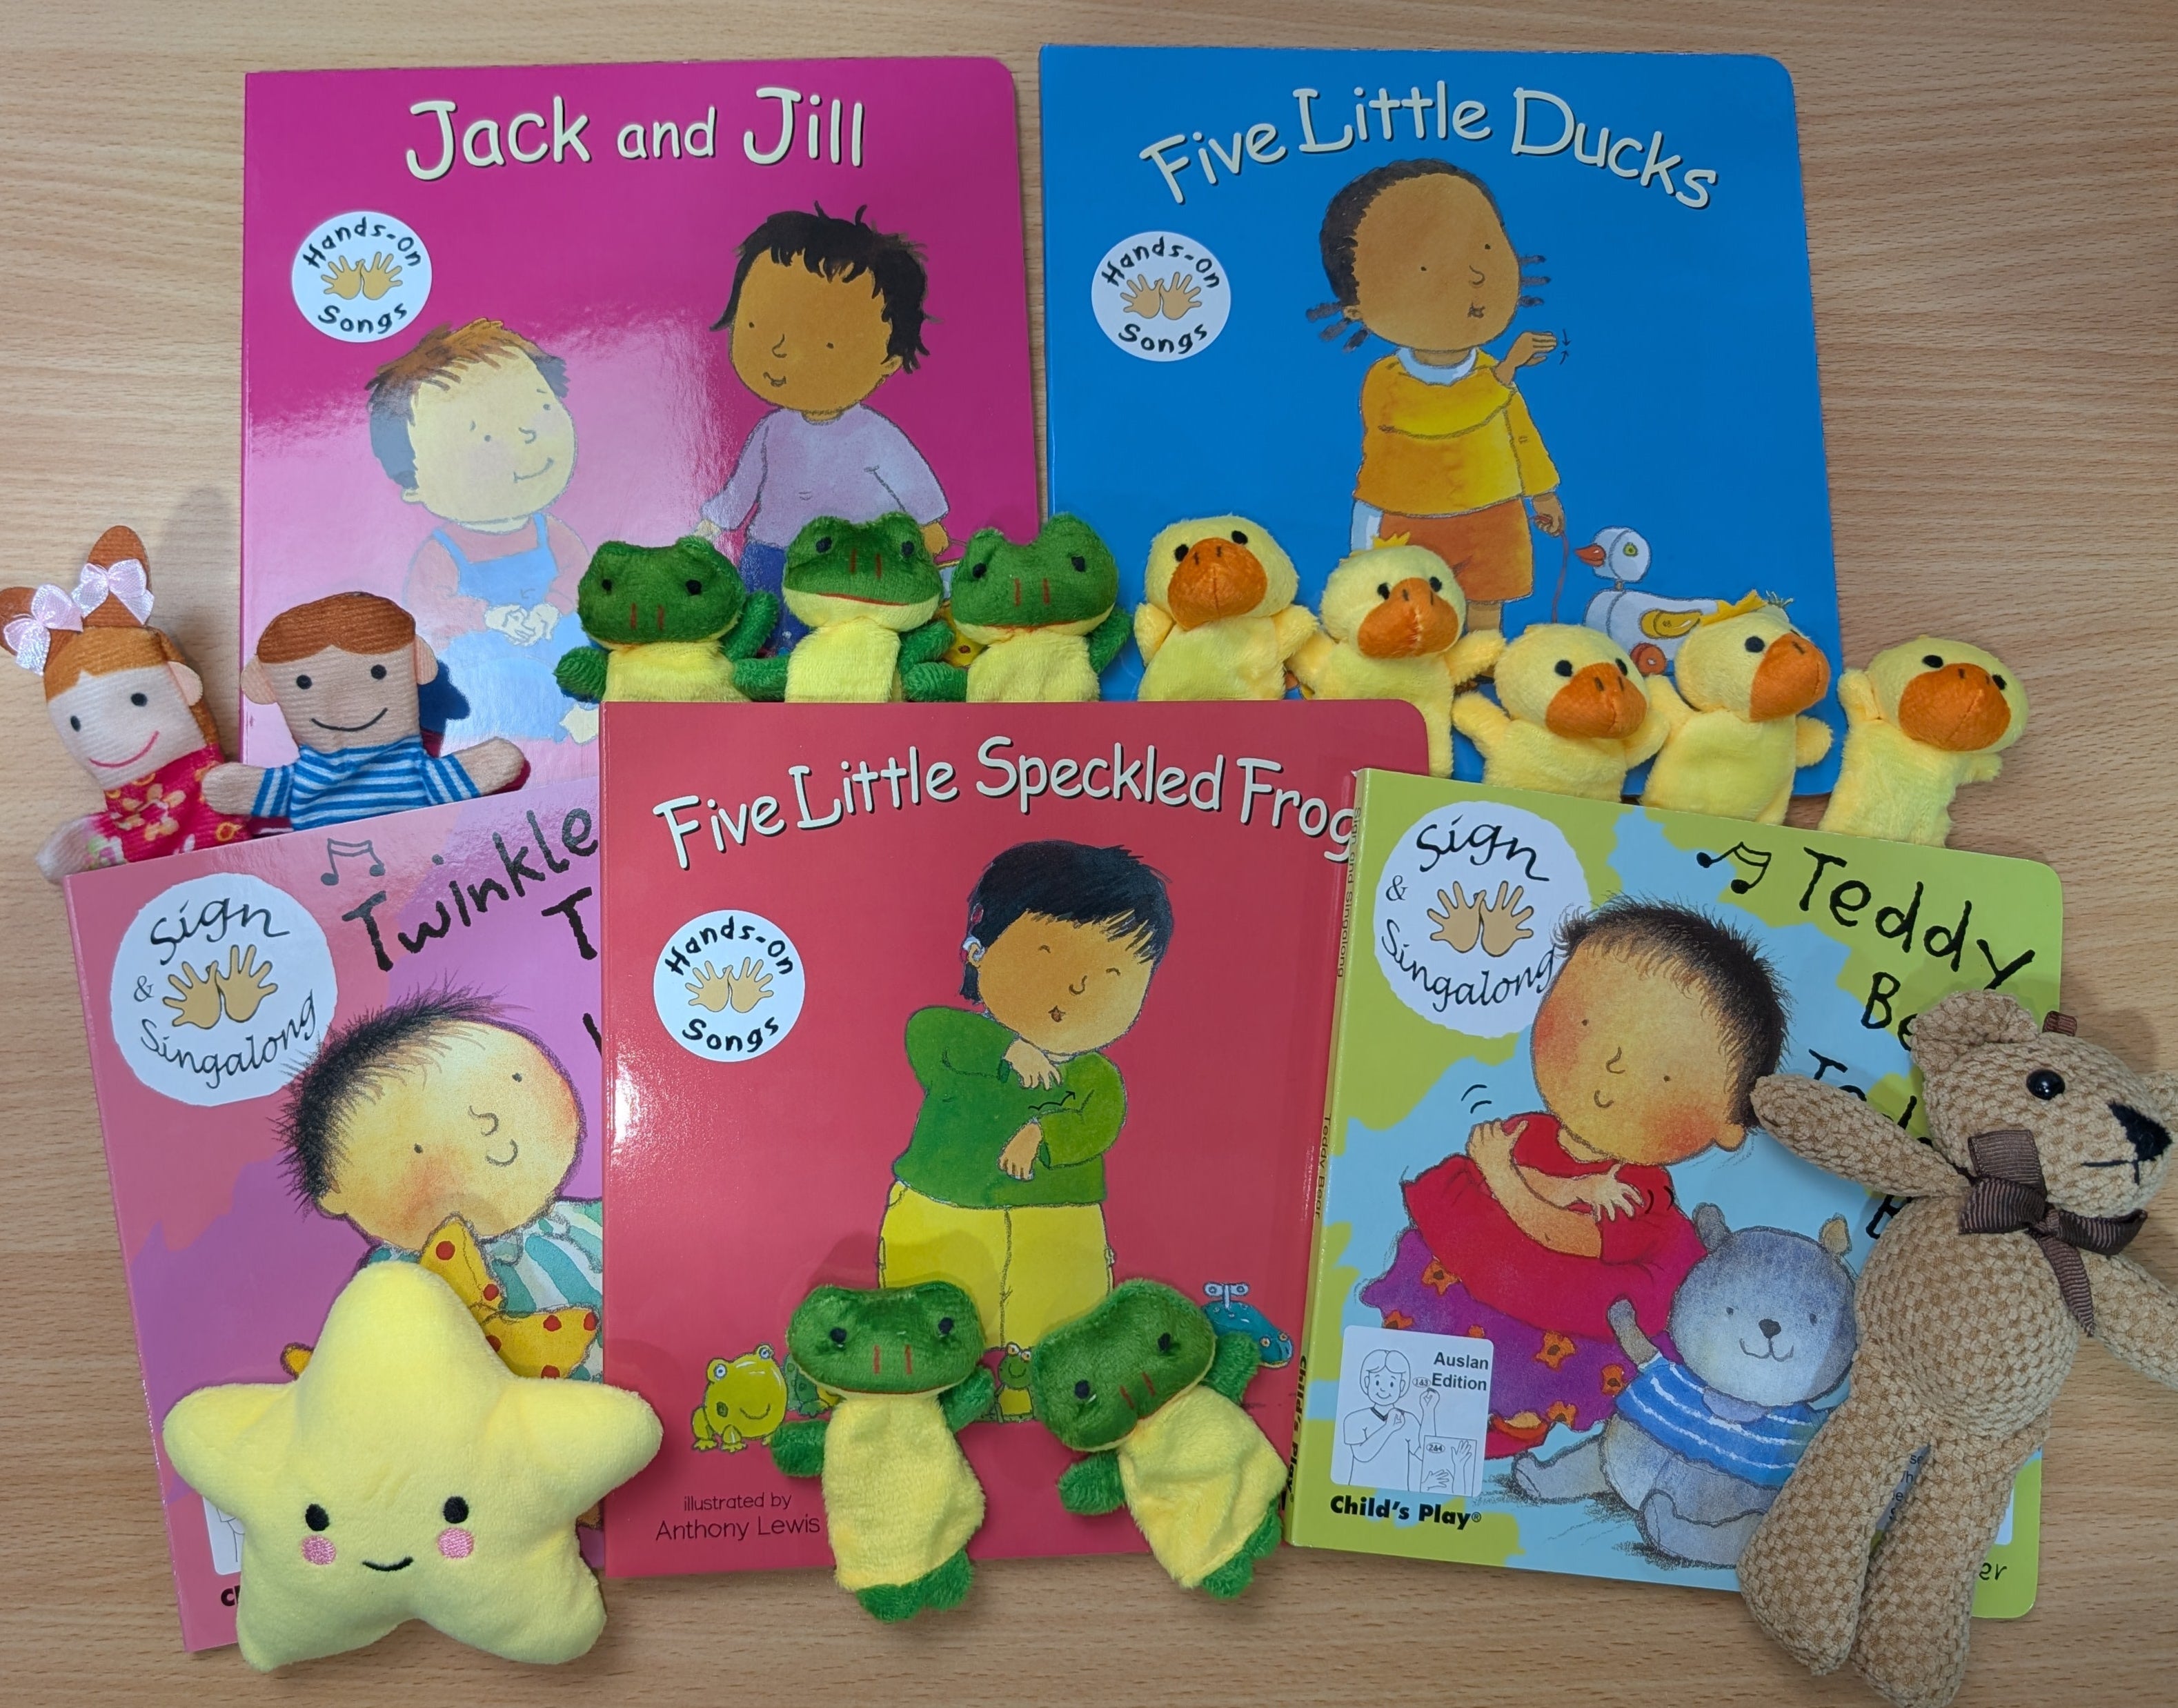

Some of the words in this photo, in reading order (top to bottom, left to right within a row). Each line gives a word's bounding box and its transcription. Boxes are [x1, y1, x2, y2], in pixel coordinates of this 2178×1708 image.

[406, 95, 591, 181] Jack
[617, 106, 718, 160] and
[743, 86, 864, 168] Jill
[1138, 123, 1287, 206] Five
[1292, 79, 1493, 154] Little
[1511, 87, 1718, 210] Ducks
[302, 216, 422, 269] Hands-On
[1101, 235, 1220, 288] Hands-On
[317, 302, 408, 334] Songs
[1118, 323, 1208, 355] Songs
[652, 795, 786, 871] Five
[788, 746, 960, 830] Little
[976, 735, 1227, 815] Speckled
[1349, 806, 1362, 845] Sign
[1347, 851, 1356, 884] and
[1416, 813, 1550, 882] Sign
[341, 806, 600, 972] Twinkle
[1385, 875, 1408, 902] &
[150, 896, 290, 966] Sign
[664, 915, 793, 975] Hands-On
[1336, 891, 1354, 978] Singalong
[1799, 846, 2036, 991] Teddy
[133, 975, 156, 1002] &
[1381, 918, 1557, 1013] Singalong
[140, 989, 317, 1089] Singalong
[682, 1016, 780, 1053] Songs
[1315, 1175, 1325, 1220] Bear
[1432, 1372, 1487, 1391] Edition
[1433, 1351, 1489, 1370] Auslan
[1293, 1355, 1307, 1432] Child's
[655, 1519, 750, 1542] Anthony
[758, 1513, 821, 1536] Lewis
[683, 1491, 764, 1511] illustrated
[771, 1492, 792, 1510] by
[1330, 1495, 1410, 1520] Child's
